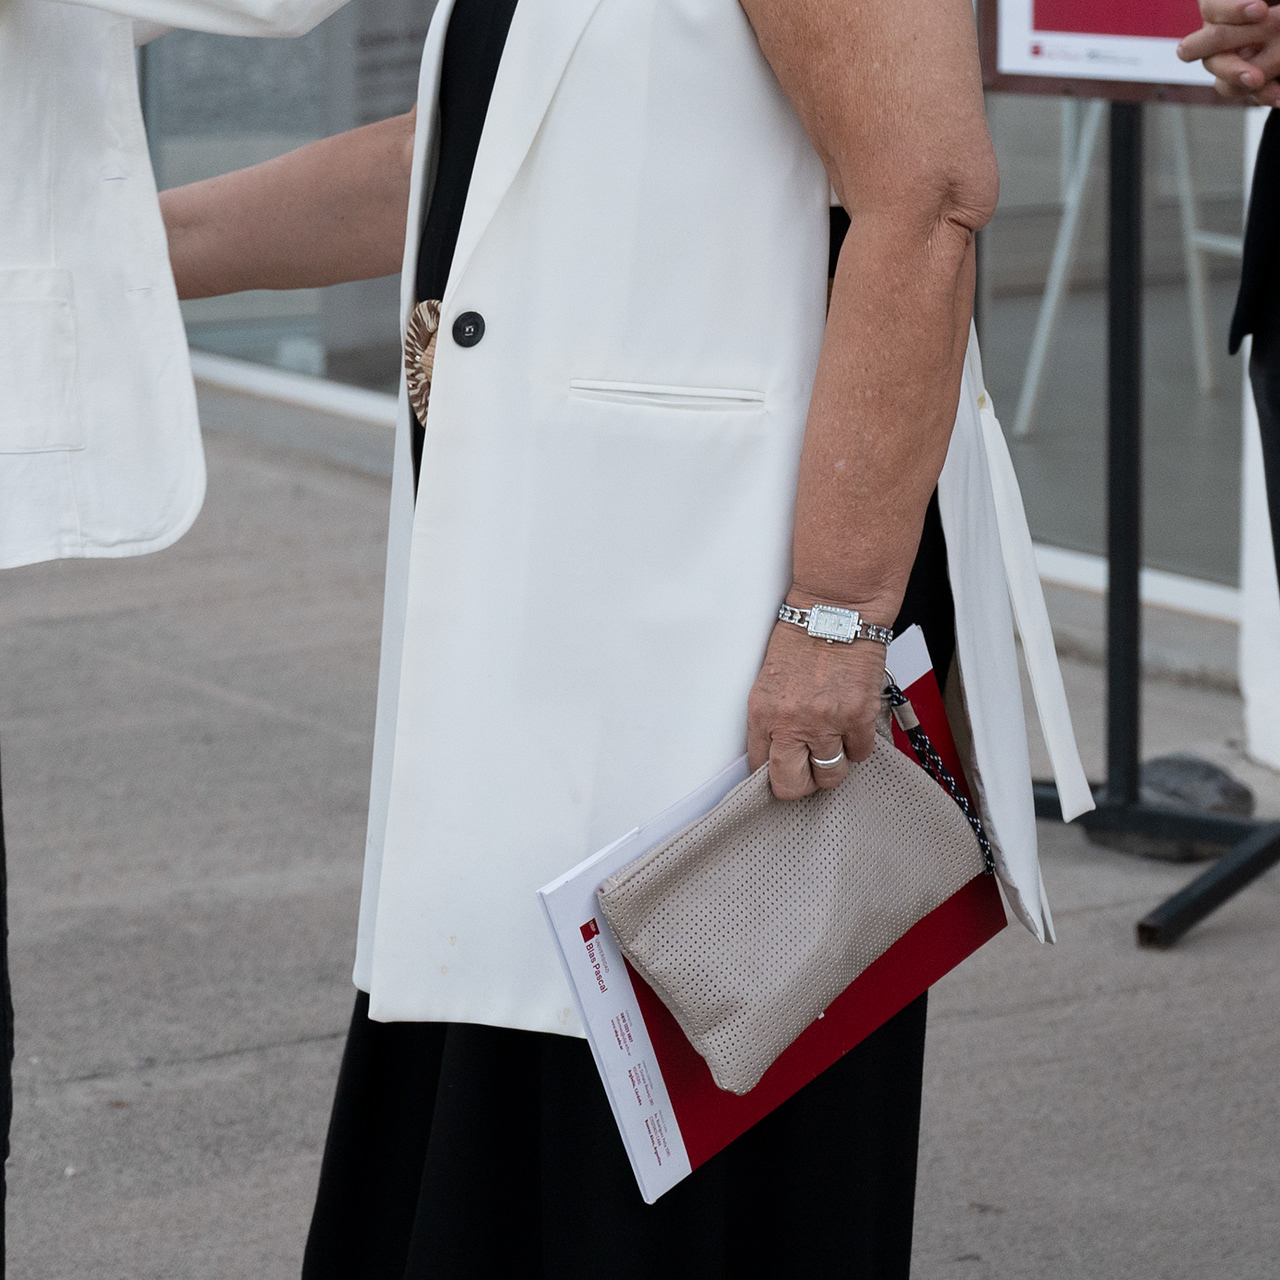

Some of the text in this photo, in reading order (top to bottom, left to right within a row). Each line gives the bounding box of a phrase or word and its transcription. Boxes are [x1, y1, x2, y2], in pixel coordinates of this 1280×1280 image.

[585, 942, 609, 994] Blas Pascal
[595, 938, 610, 974] UNIVERSIDAD
